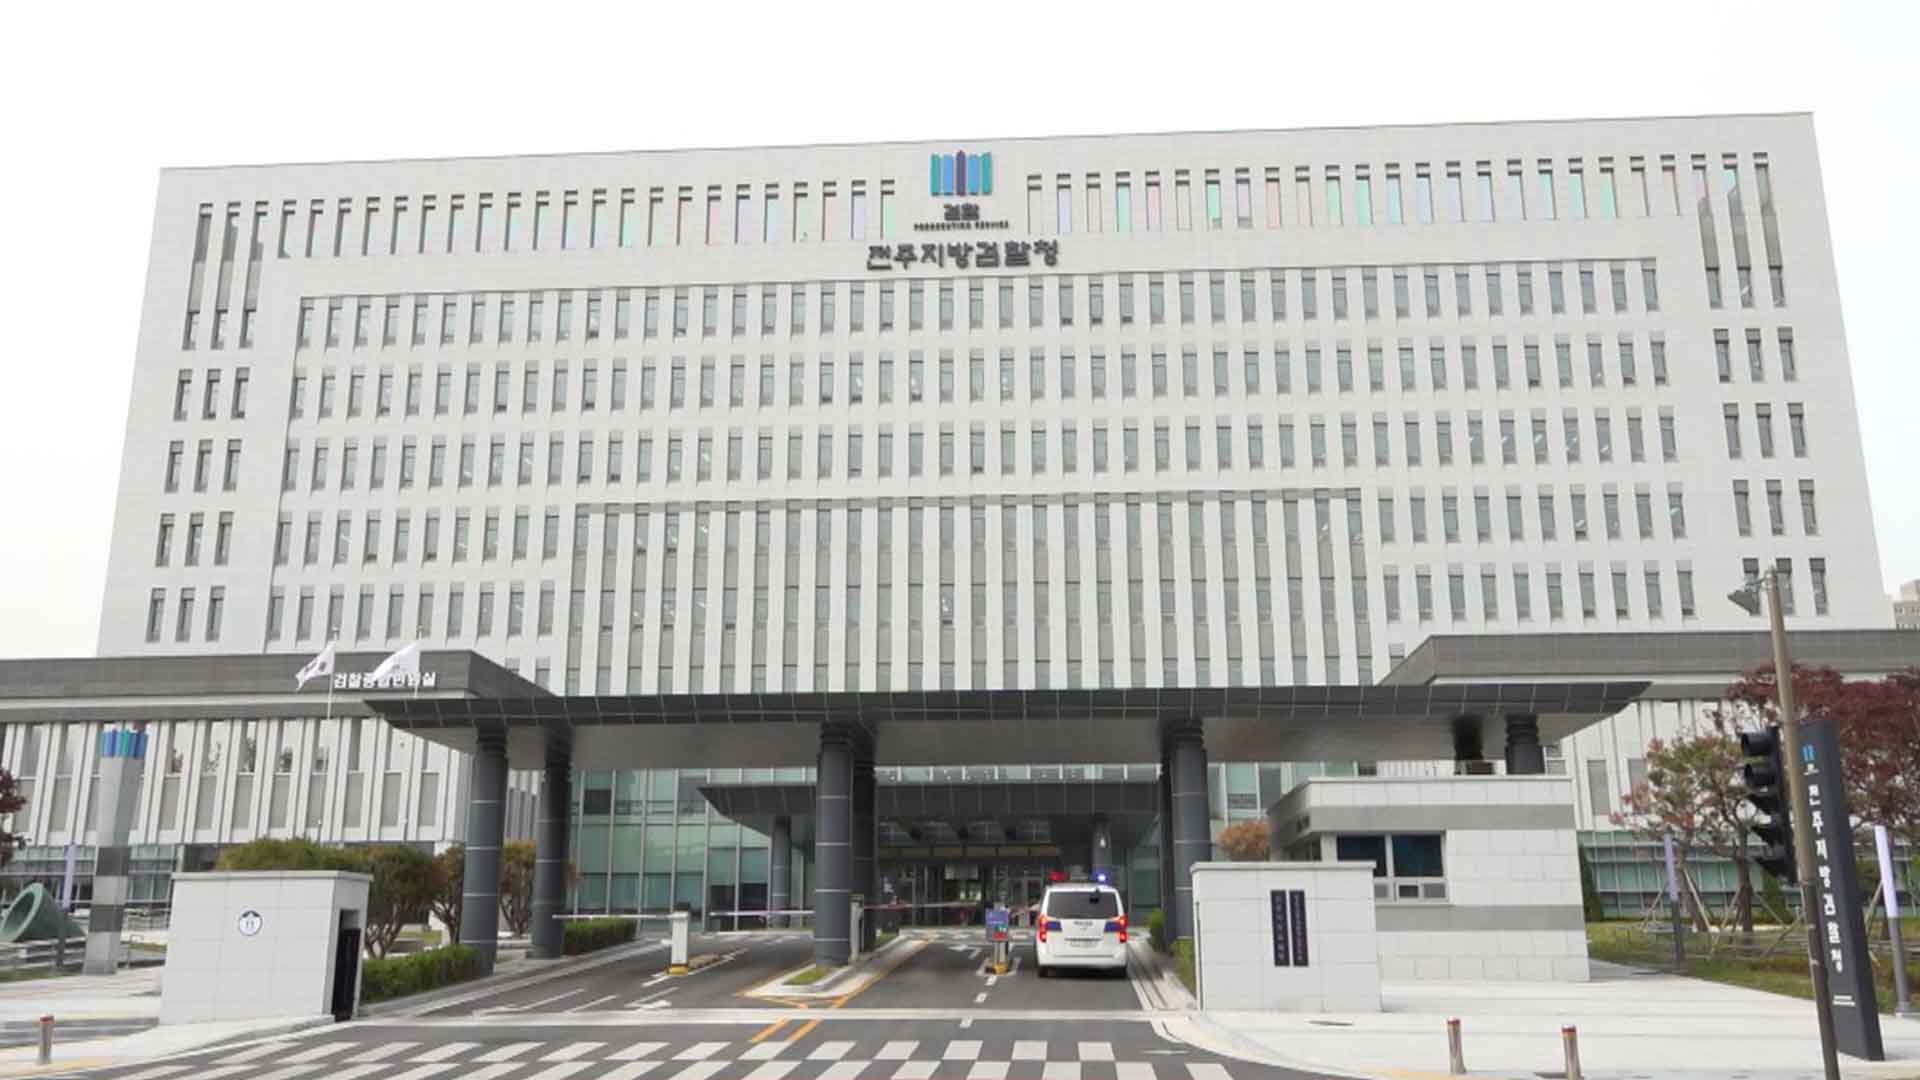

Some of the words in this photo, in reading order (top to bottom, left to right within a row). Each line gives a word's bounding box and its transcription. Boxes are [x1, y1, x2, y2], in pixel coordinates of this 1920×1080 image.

[944, 202, 980, 221] 검찰
[866, 239, 1059, 271] 전주지방검찰청
[1808, 783, 1843, 974] 전주지방검찰청
